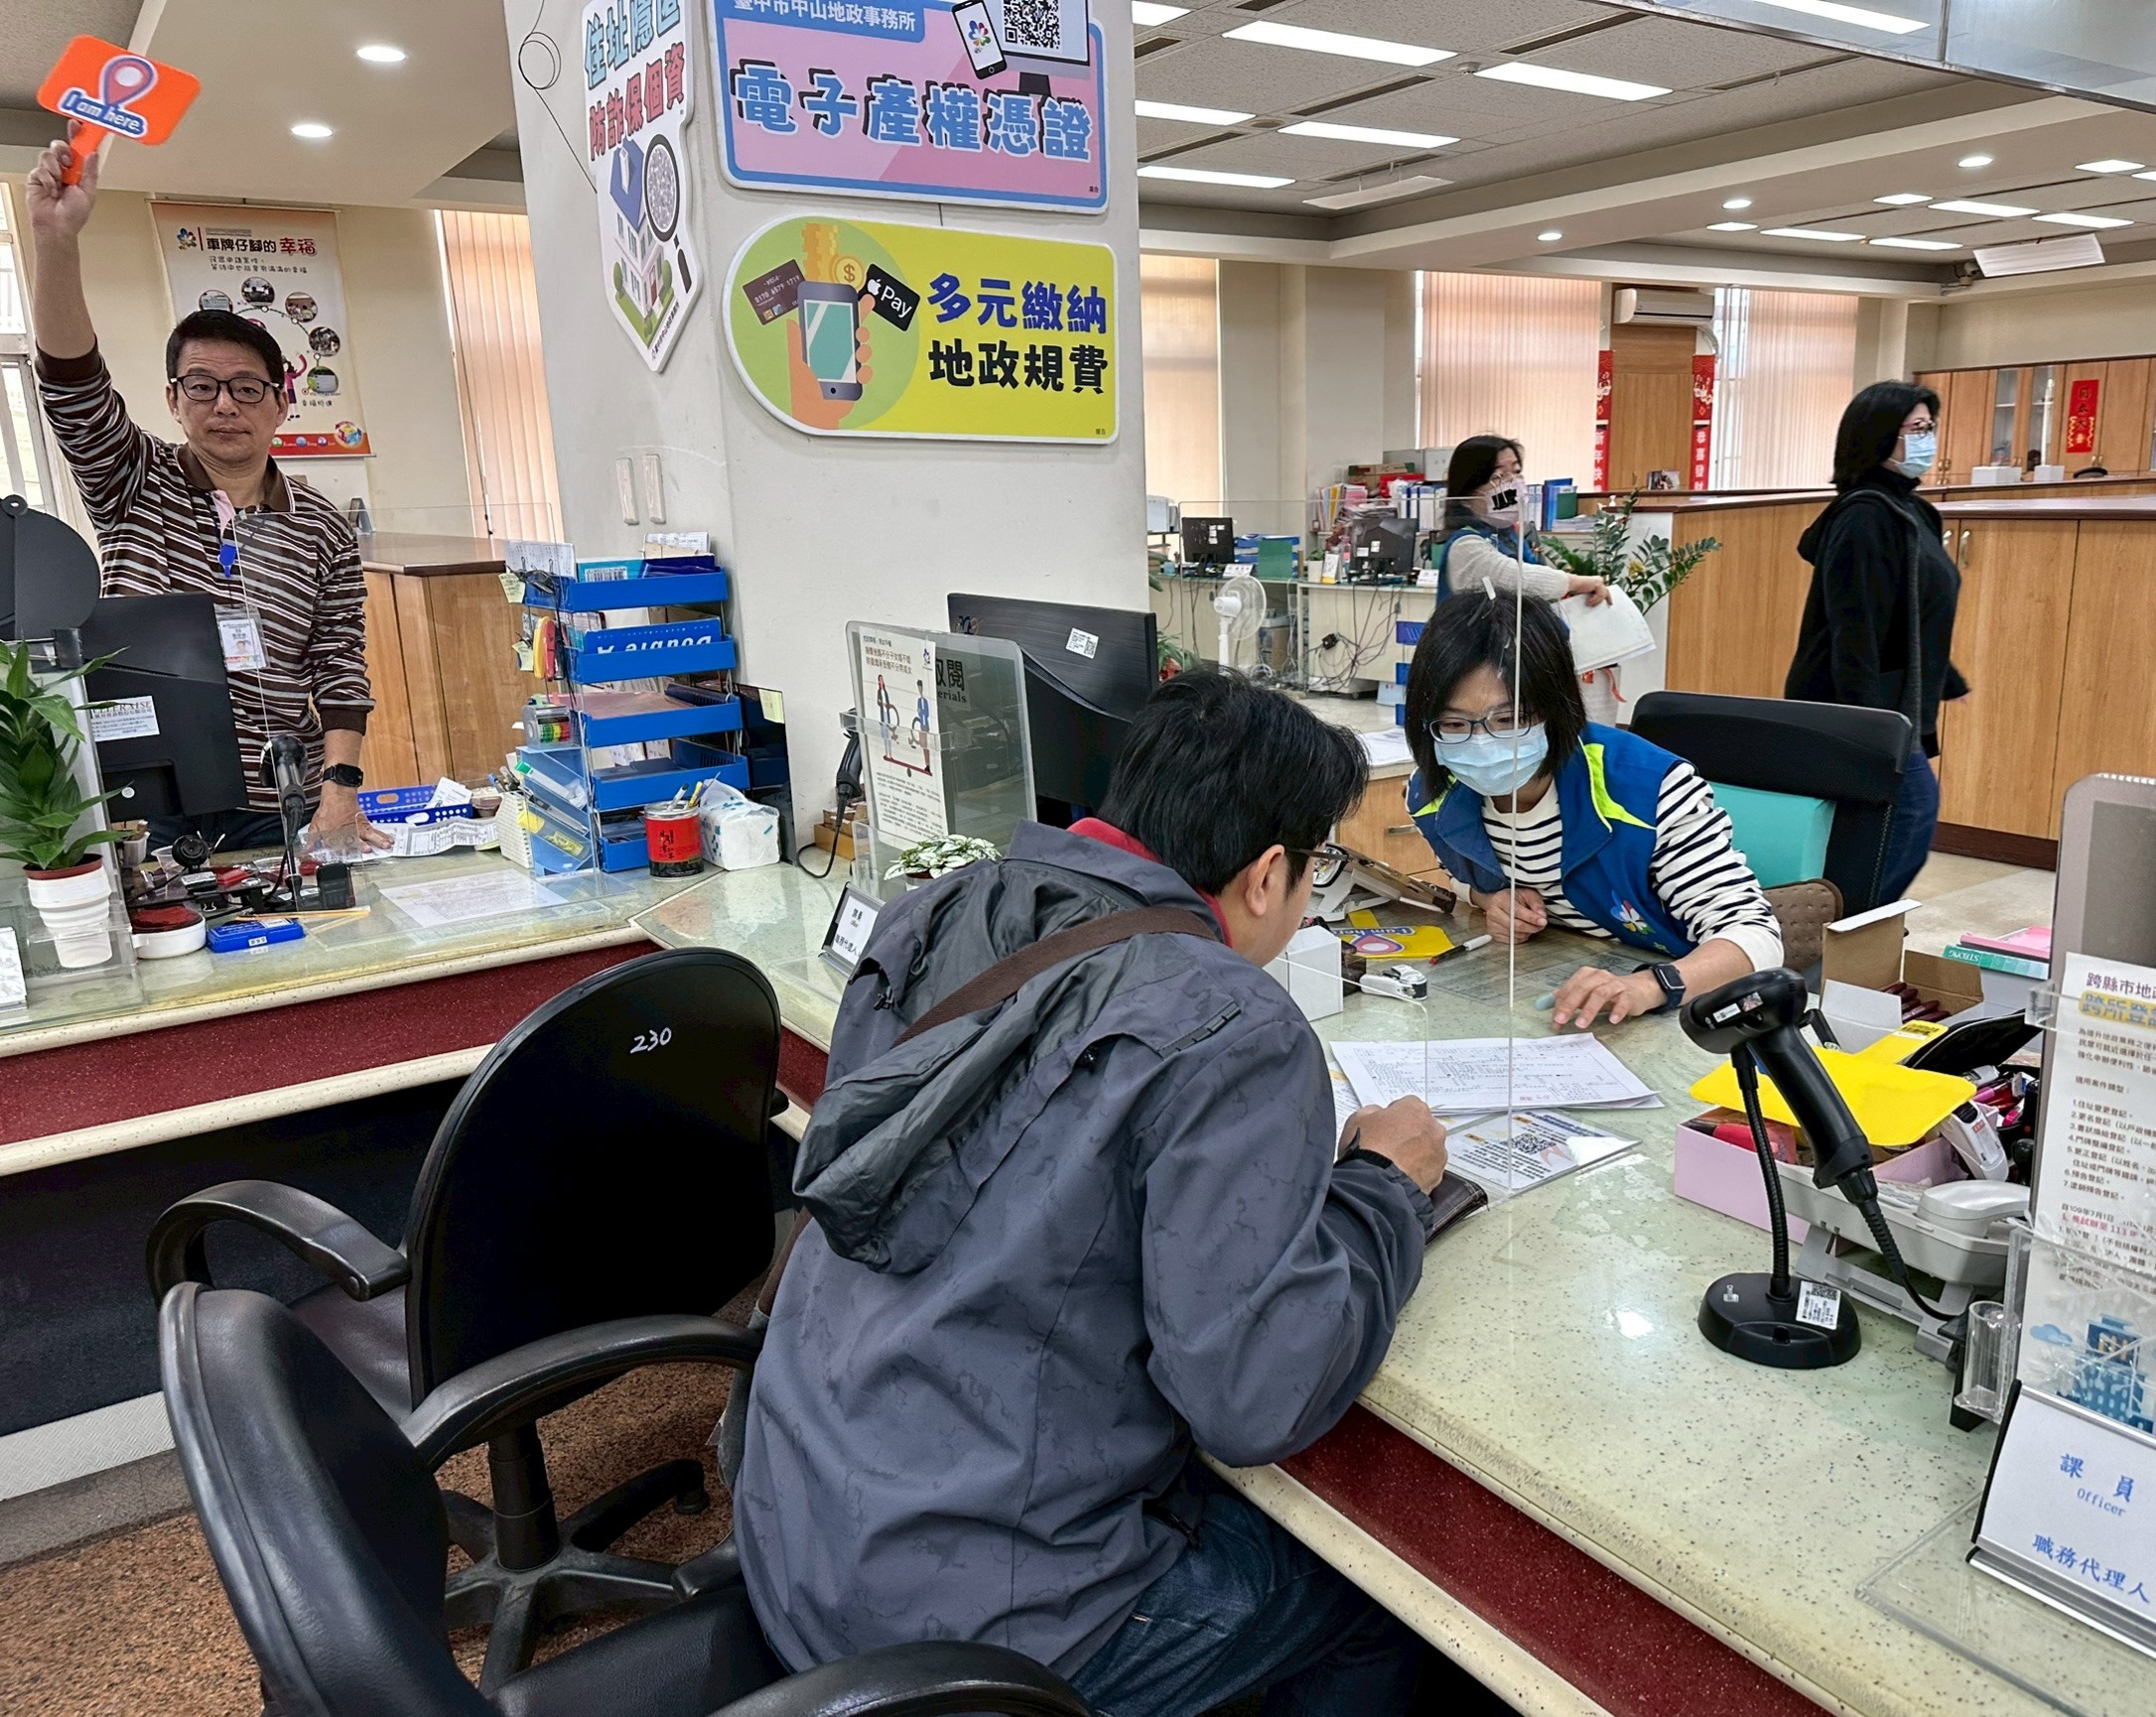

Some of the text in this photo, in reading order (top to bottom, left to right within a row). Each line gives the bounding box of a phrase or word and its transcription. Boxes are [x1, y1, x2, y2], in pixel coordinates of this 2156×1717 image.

[589, 41, 685, 162] 防詐保個資
[732, 61, 1092, 162] 電子產權憑證
[880, 285, 913, 319] Pay
[927, 272, 1107, 334] 多元繳納
[928, 337, 1109, 395] 地政規費
[2086, 972, 2156, 999] 跨縣市地
[629, 1026, 672, 1054] 230
[2077, 1487, 2127, 1517] Officer
[2032, 1533, 2151, 1605] 職務代理人
